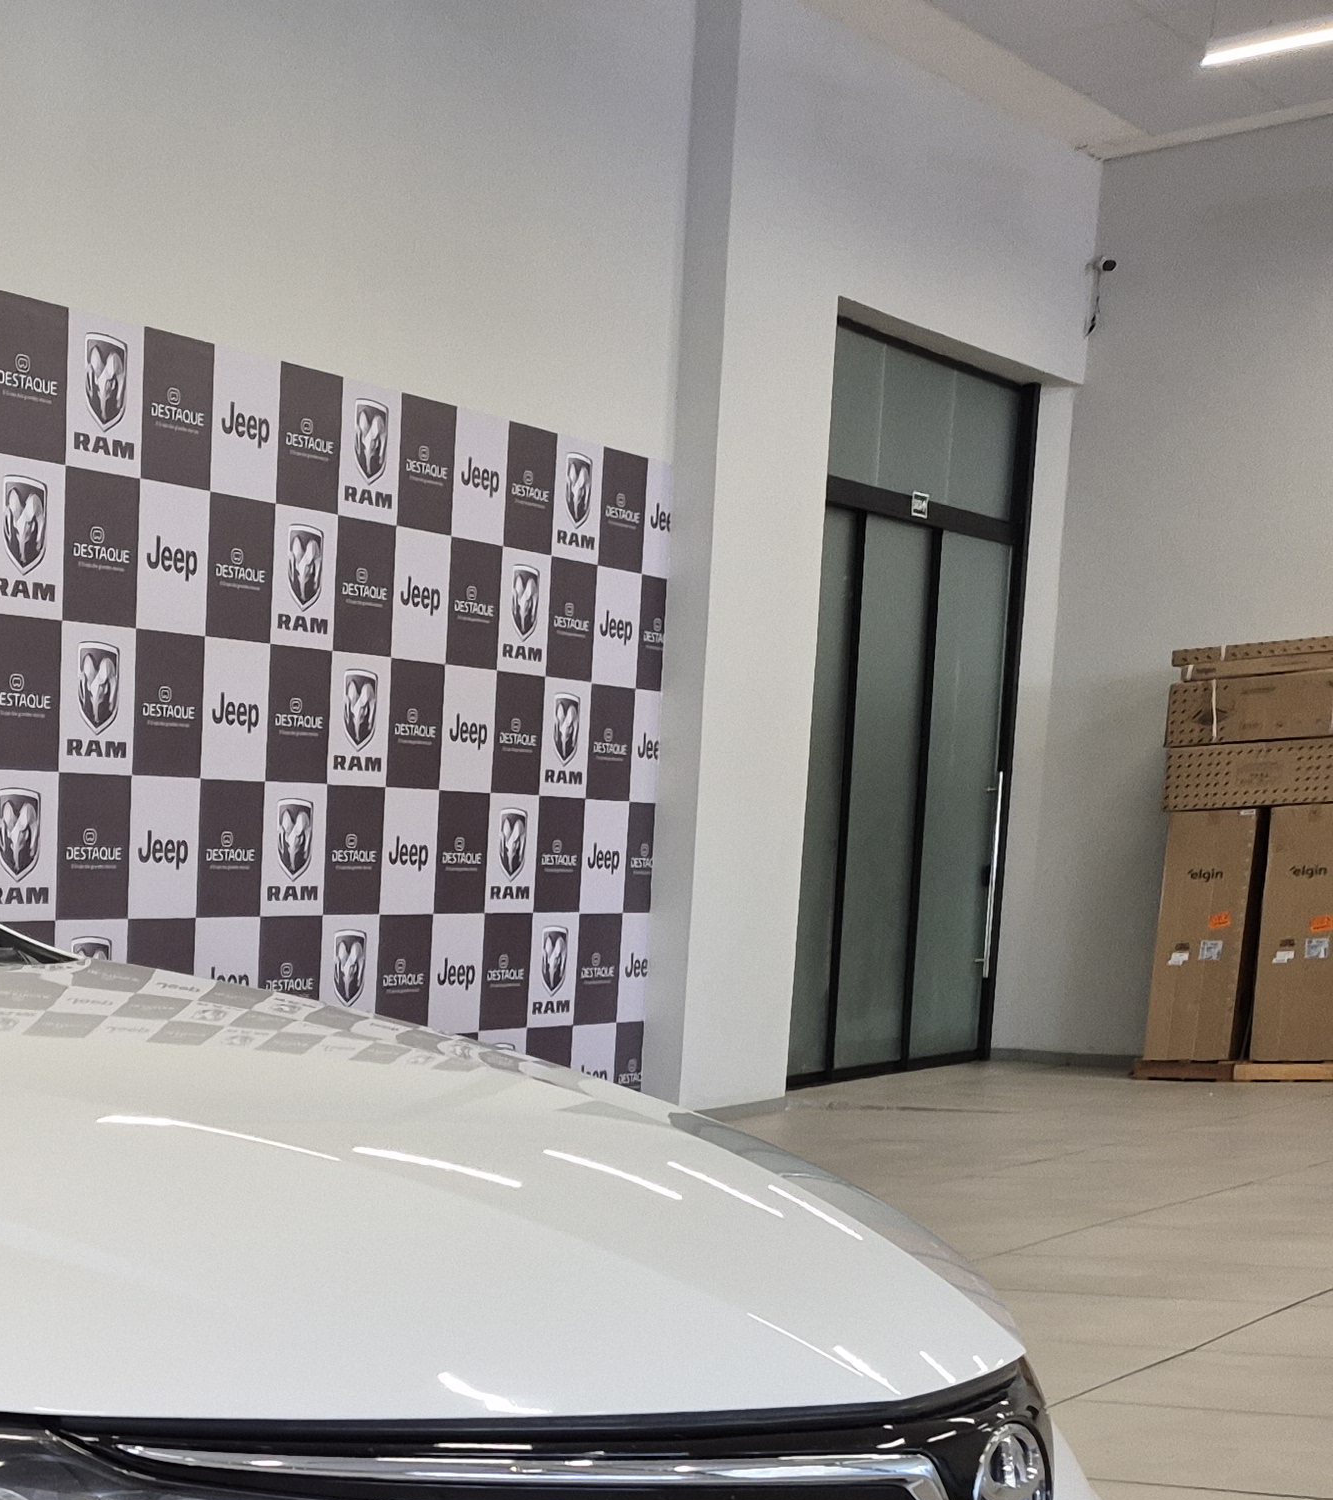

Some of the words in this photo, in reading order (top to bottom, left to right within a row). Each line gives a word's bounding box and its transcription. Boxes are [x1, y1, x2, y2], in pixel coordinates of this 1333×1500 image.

[150, 401, 205, 429] DESTAQUE
[221, 401, 270, 449] Jeep
[74, 432, 135, 460] RAM
[285, 431, 334, 457] DESTAQUE
[405, 457, 448, 480] DESTAQUE
[461, 457, 500, 497] Jeep
[344, 486, 392, 509] RAM
[511, 483, 549, 502] DESTAQUE
[605, 505, 640, 524] DESTAQUE
[557, 530, 595, 549] RAM
[73, 542, 130, 567] DESTAQUE
[146, 535, 198, 582] Jeep
[216, 564, 265, 584] DESTAQUE
[341, 580, 387, 601] DESTAQUE
[400, 576, 441, 616] Jeep
[454, 599, 494, 617] DESTAQUE
[277, 614, 328, 635] RAM
[553, 615, 589, 632] DESTAQUE
[599, 610, 633, 645] Jeep
[503, 644, 542, 661] RAM
[142, 702, 195, 720] DESTAQUE
[212, 692, 259, 733] Jeep
[274, 713, 323, 729] DESTAQUE
[394, 723, 436, 738] DESTAQUE
[449, 713, 488, 750] Jeep
[499, 732, 537, 747] DESTAQUE
[67, 739, 127, 758] RAM
[593, 742, 626, 755] DESTAQUE
[333, 755, 382, 772] RAM
[545, 770, 582, 784] RAM
[65, 846, 122, 861] DESTAQUE
[138, 830, 189, 870] Jeep
[205, 848, 255, 862] DESTAQUE
[331, 849, 376, 863] DESTAQUE
[388, 836, 429, 871] Jeep
[442, 851, 482, 865] DESTAQUE
[587, 843, 620, 874] Jeep
[541, 854, 577, 866] DESTAQUE
[1188, 868, 1223, 882] elgin
[1290, 865, 1328, 878] elgin
[267, 886, 318, 901] RAM
[491, 886, 529, 899] RAM
[382, 973, 424, 987] DESTAQUE
[437, 958, 476, 990] Jeep
[487, 965, 524, 981] DESTAQUE
[581, 966, 614, 978] DESTAQUE
[532, 1000, 570, 1014] RAM
